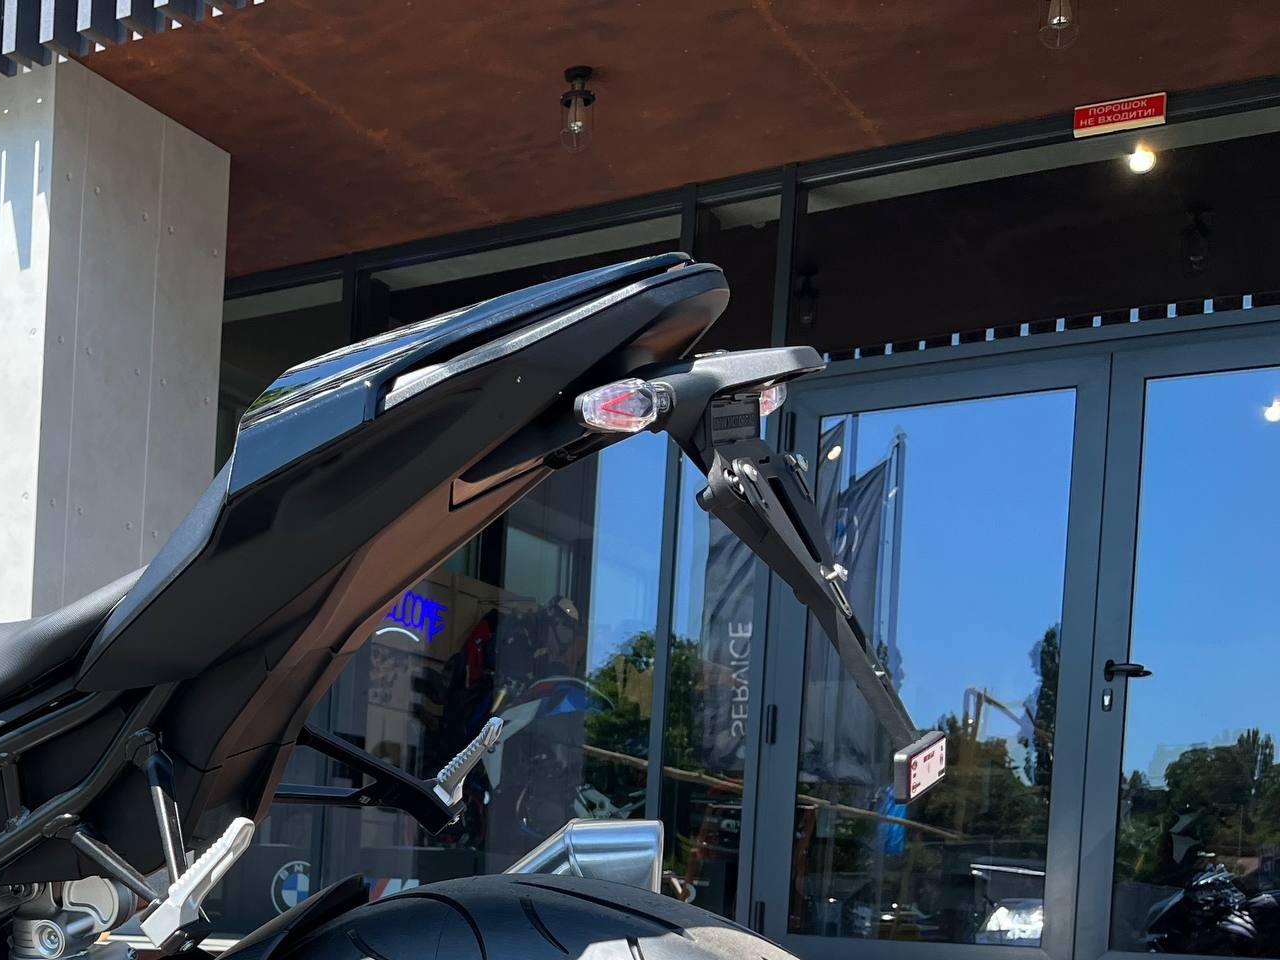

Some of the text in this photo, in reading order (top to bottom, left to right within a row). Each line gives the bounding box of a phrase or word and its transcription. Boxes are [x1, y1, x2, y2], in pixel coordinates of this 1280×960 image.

[1088, 99, 1148, 116] ПОРОШОК
[1080, 108, 1156, 127] НЕ ВХОДИТИ!
